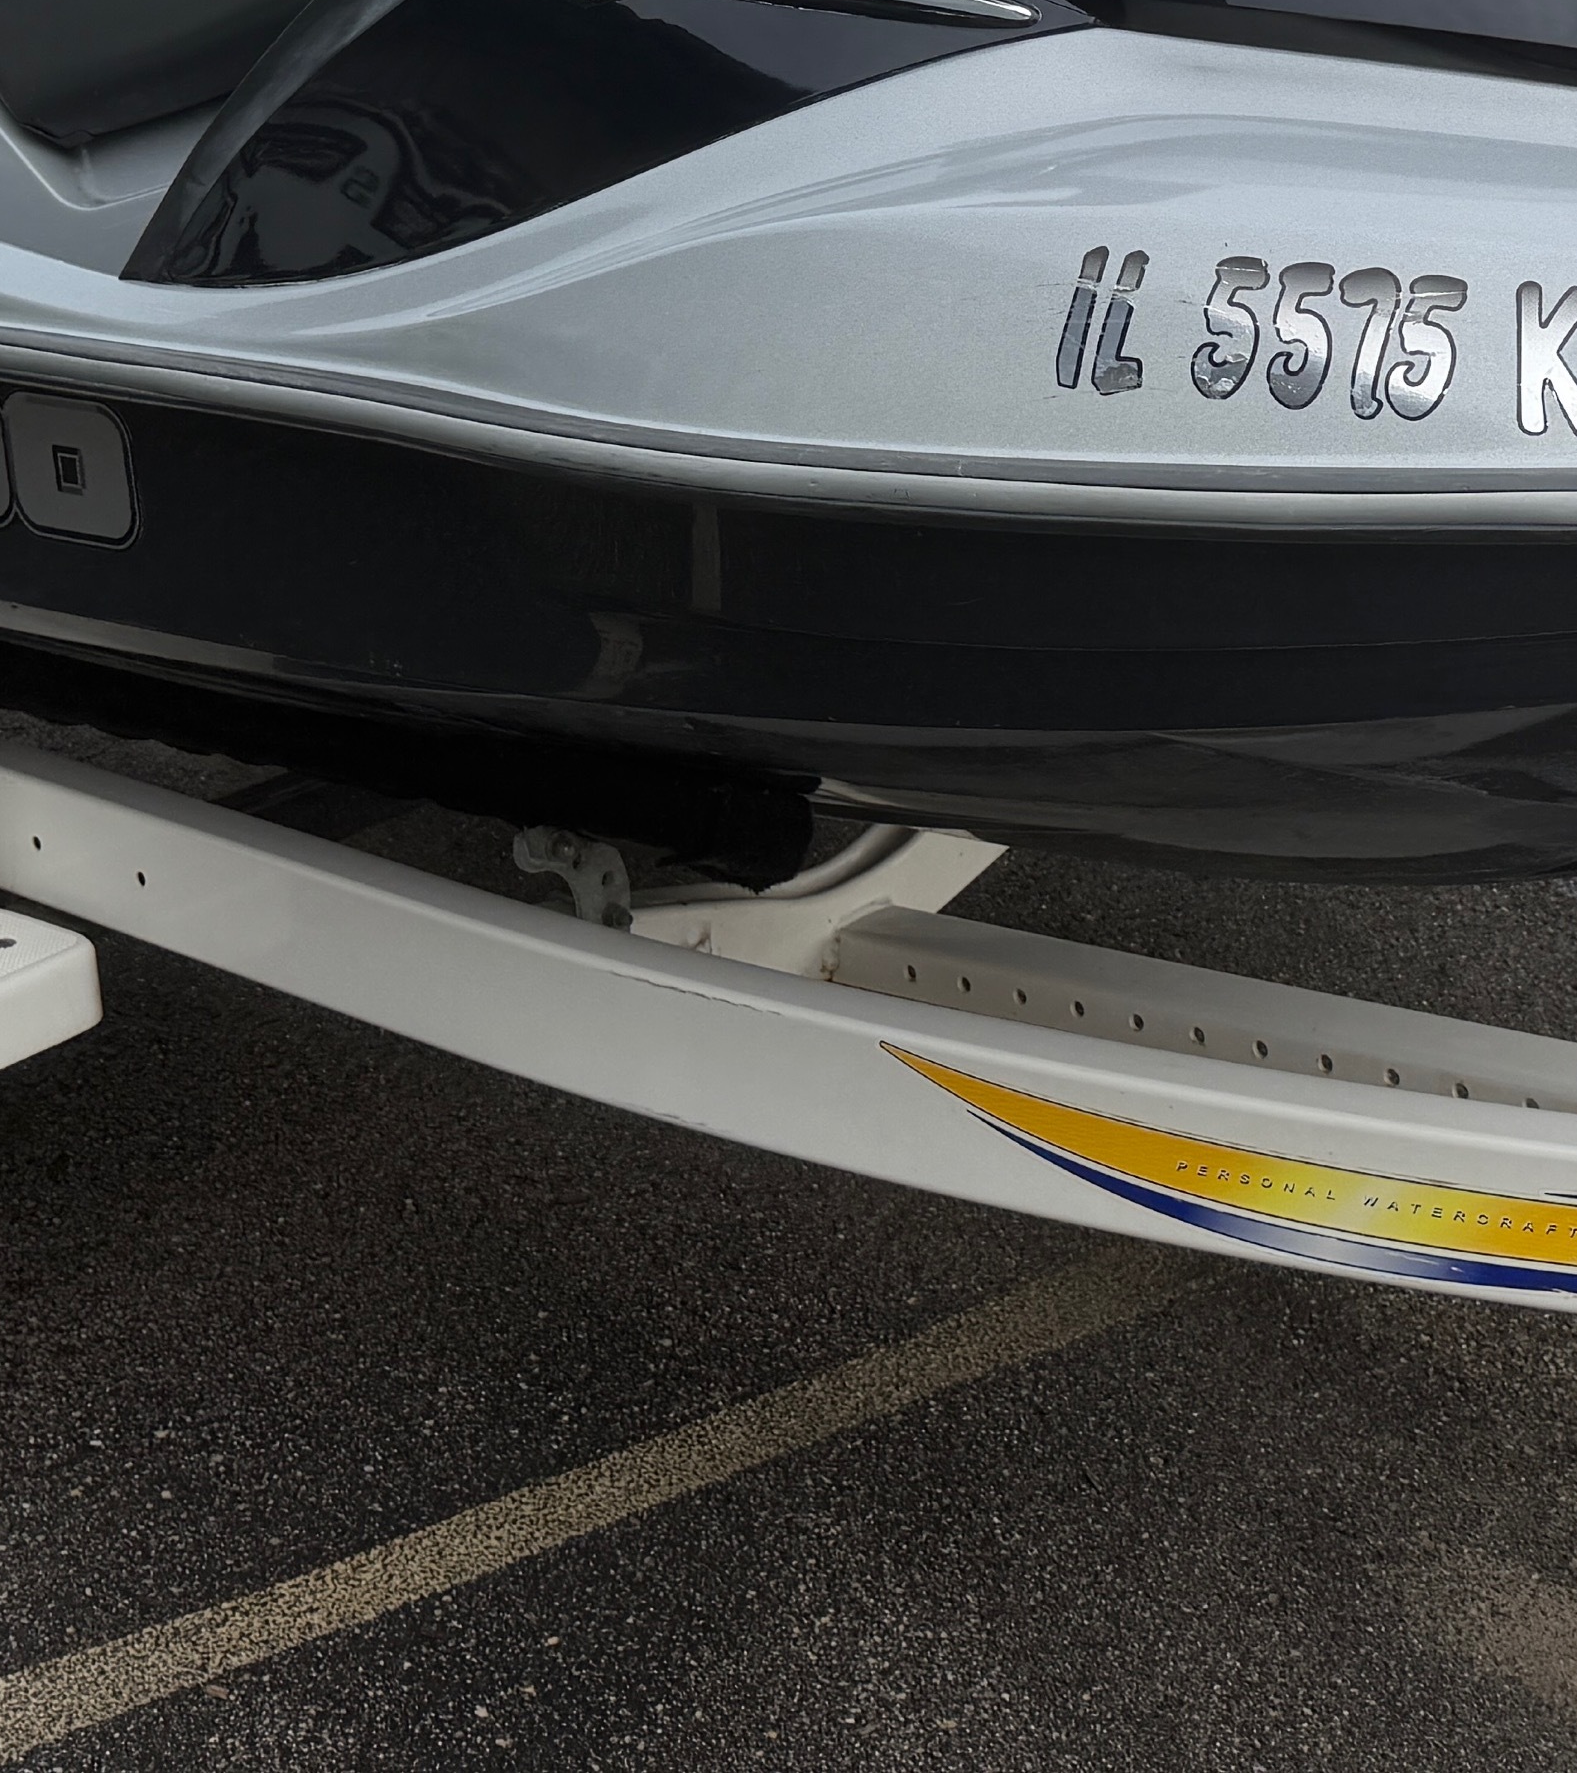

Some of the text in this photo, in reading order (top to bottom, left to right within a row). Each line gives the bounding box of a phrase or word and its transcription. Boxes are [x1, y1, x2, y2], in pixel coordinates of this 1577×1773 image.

[1056, 246, 1150, 395] IL
[1191, 256, 1468, 420] 5575
[1176, 1161, 1336, 1201] PERSONAL
